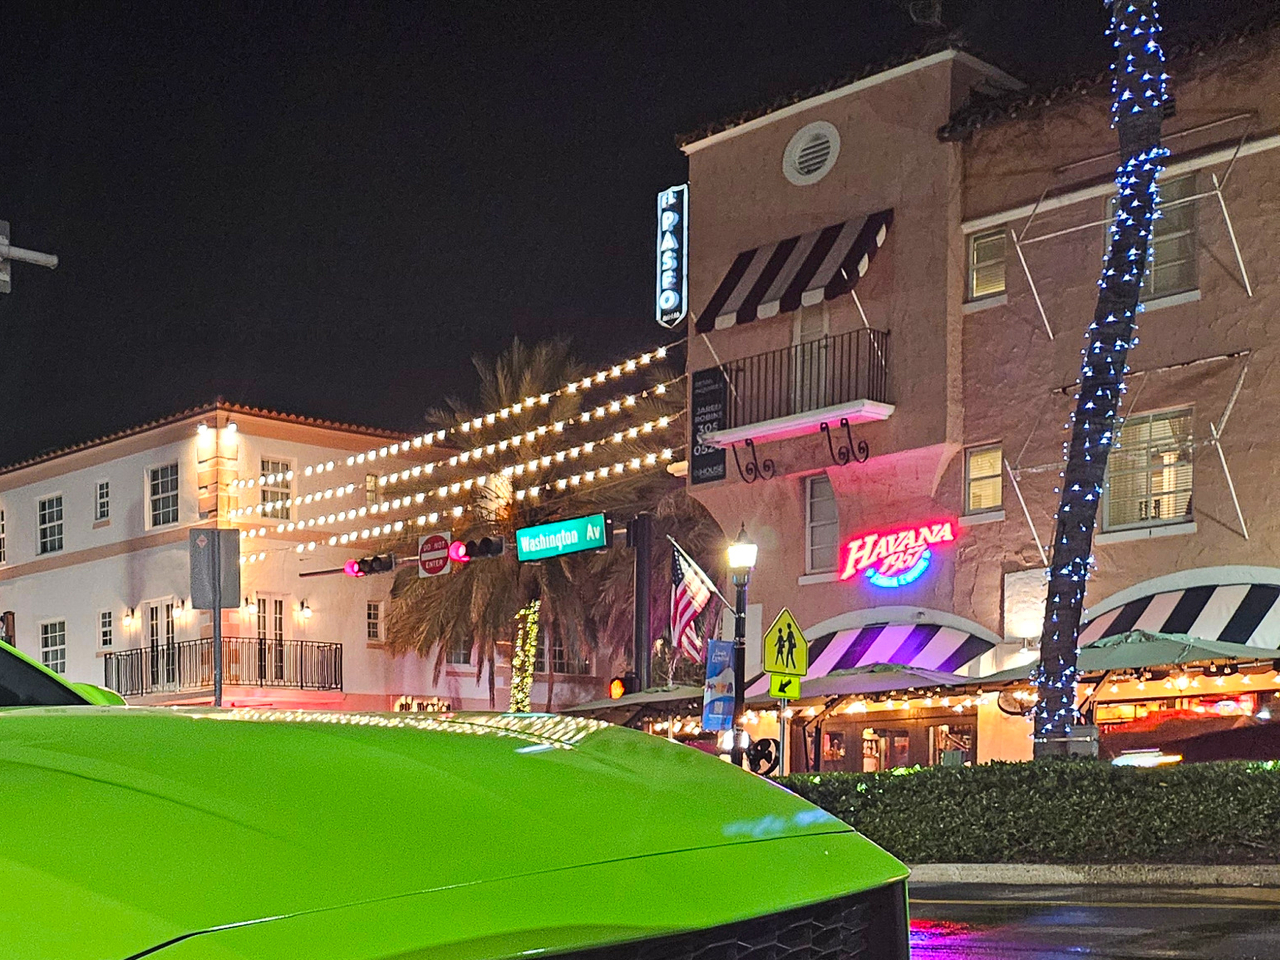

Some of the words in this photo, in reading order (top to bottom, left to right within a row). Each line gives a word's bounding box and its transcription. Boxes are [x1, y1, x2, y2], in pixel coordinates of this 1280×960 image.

[660, 210, 680, 310] PASEO
[423, 543, 431, 552] DO
[433, 540, 445, 549] NOT
[521, 529, 578, 552] Washington
[586, 523, 600, 541] Av
[840, 522, 954, 581] HAVANA
[425, 559, 443, 569] ENTER
[878, 543, 928, 577] 1957
